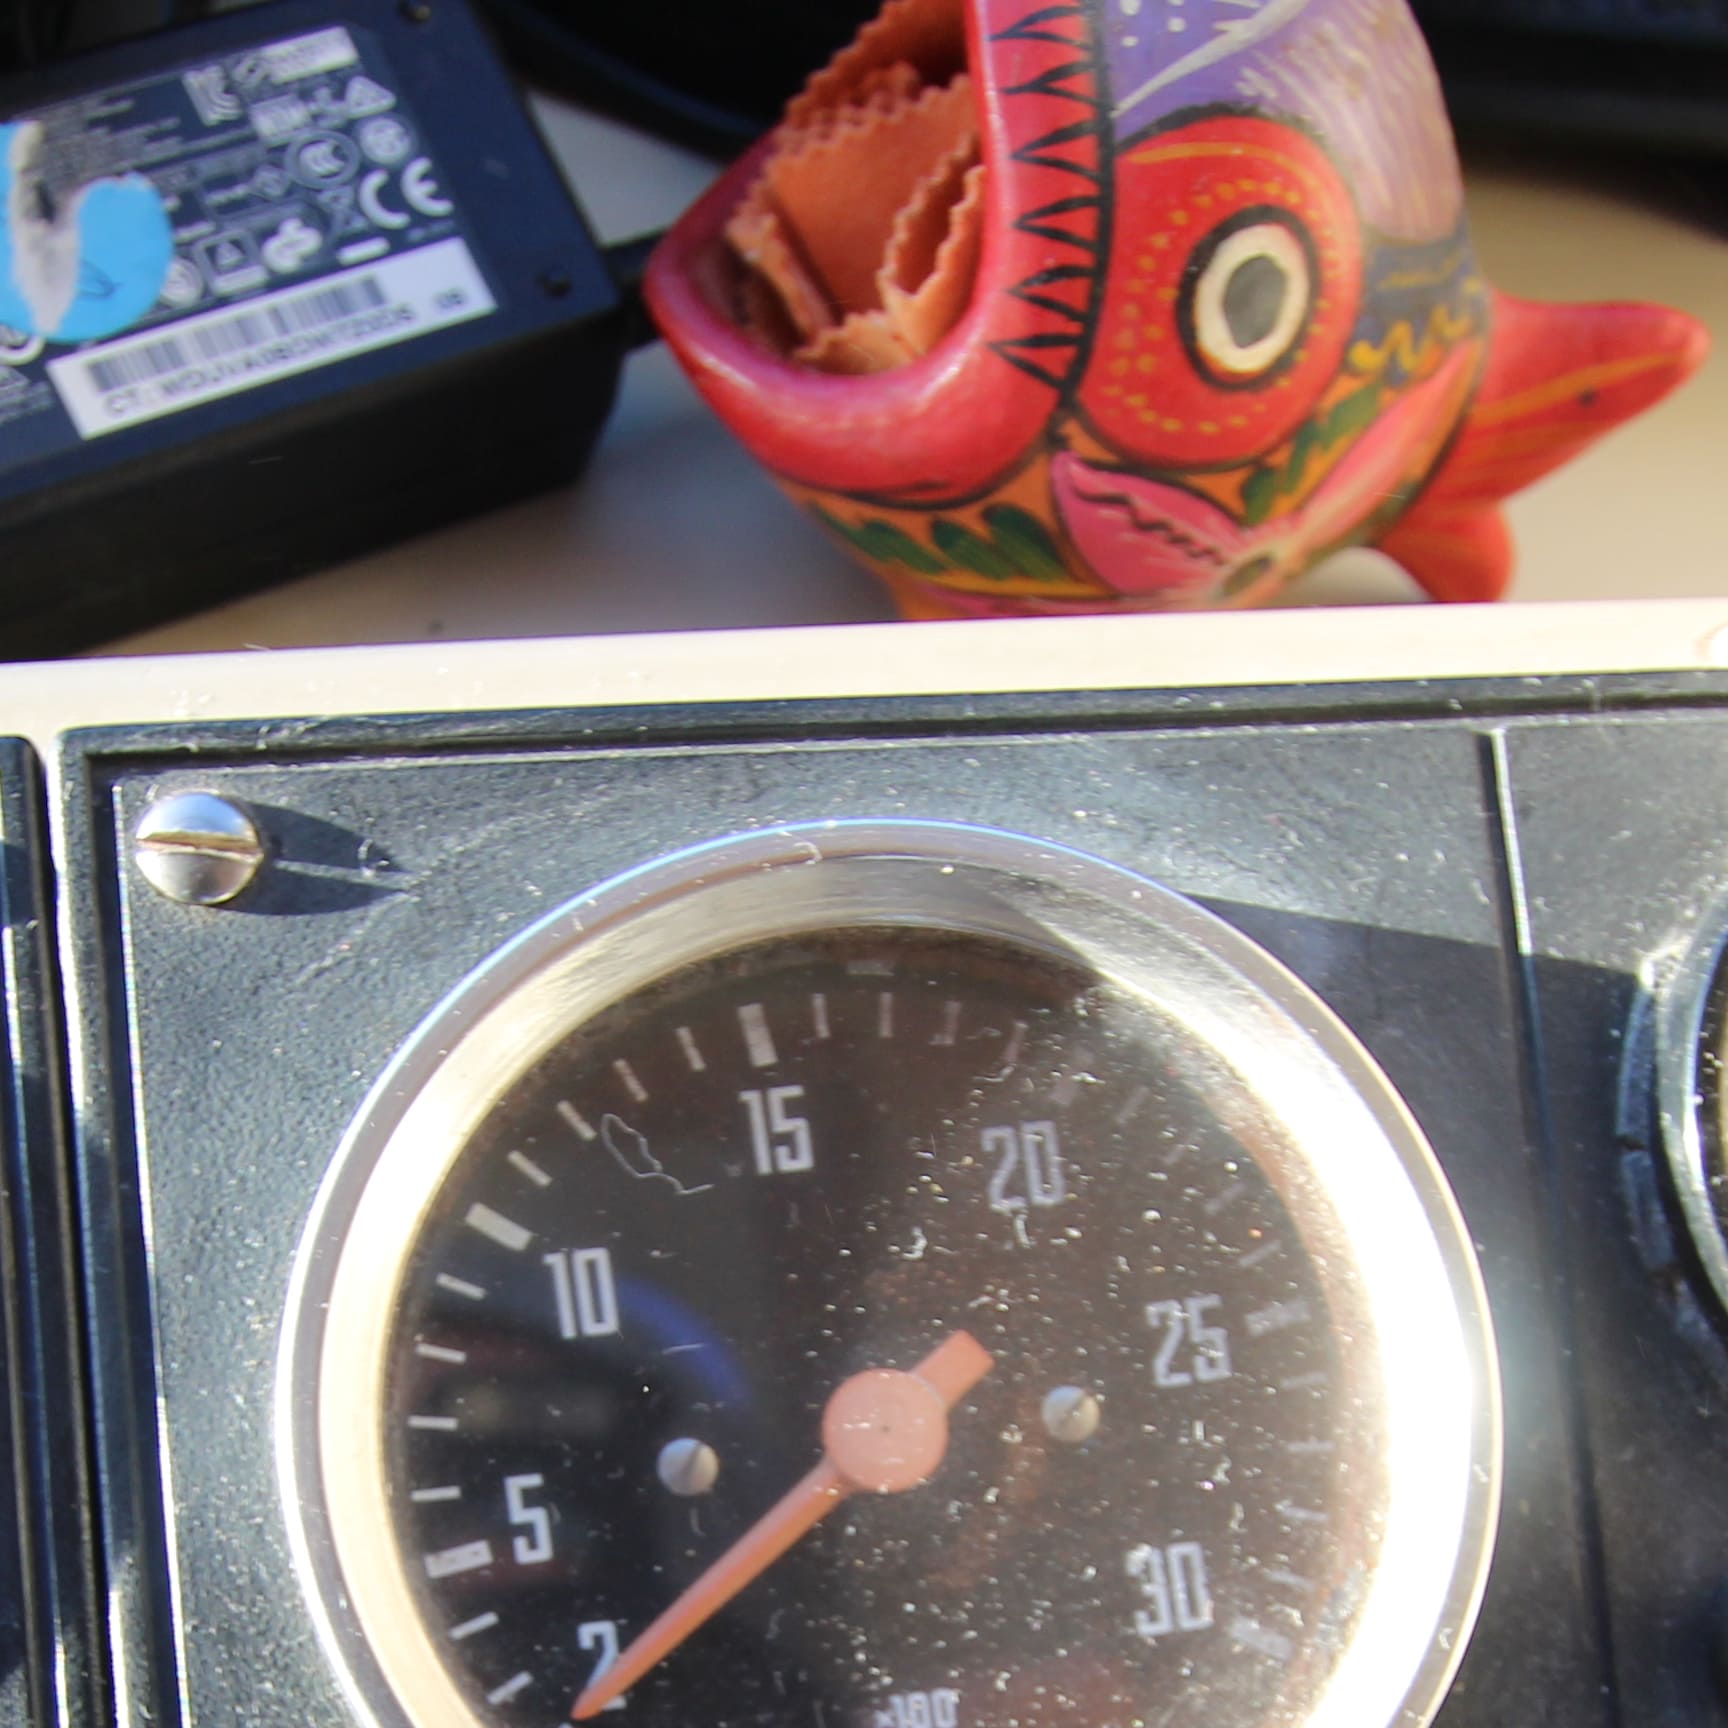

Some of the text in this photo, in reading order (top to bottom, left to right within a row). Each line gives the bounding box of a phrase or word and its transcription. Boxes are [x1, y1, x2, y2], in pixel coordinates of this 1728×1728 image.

[738, 1085, 814, 1176] 15
[981, 1120, 1066, 1209] 20
[543, 1247, 620, 1340] 10
[1145, 1295, 1232, 1388] 25
[504, 1472, 554, 1565] 5
[1125, 1541, 1215, 1637] 30
